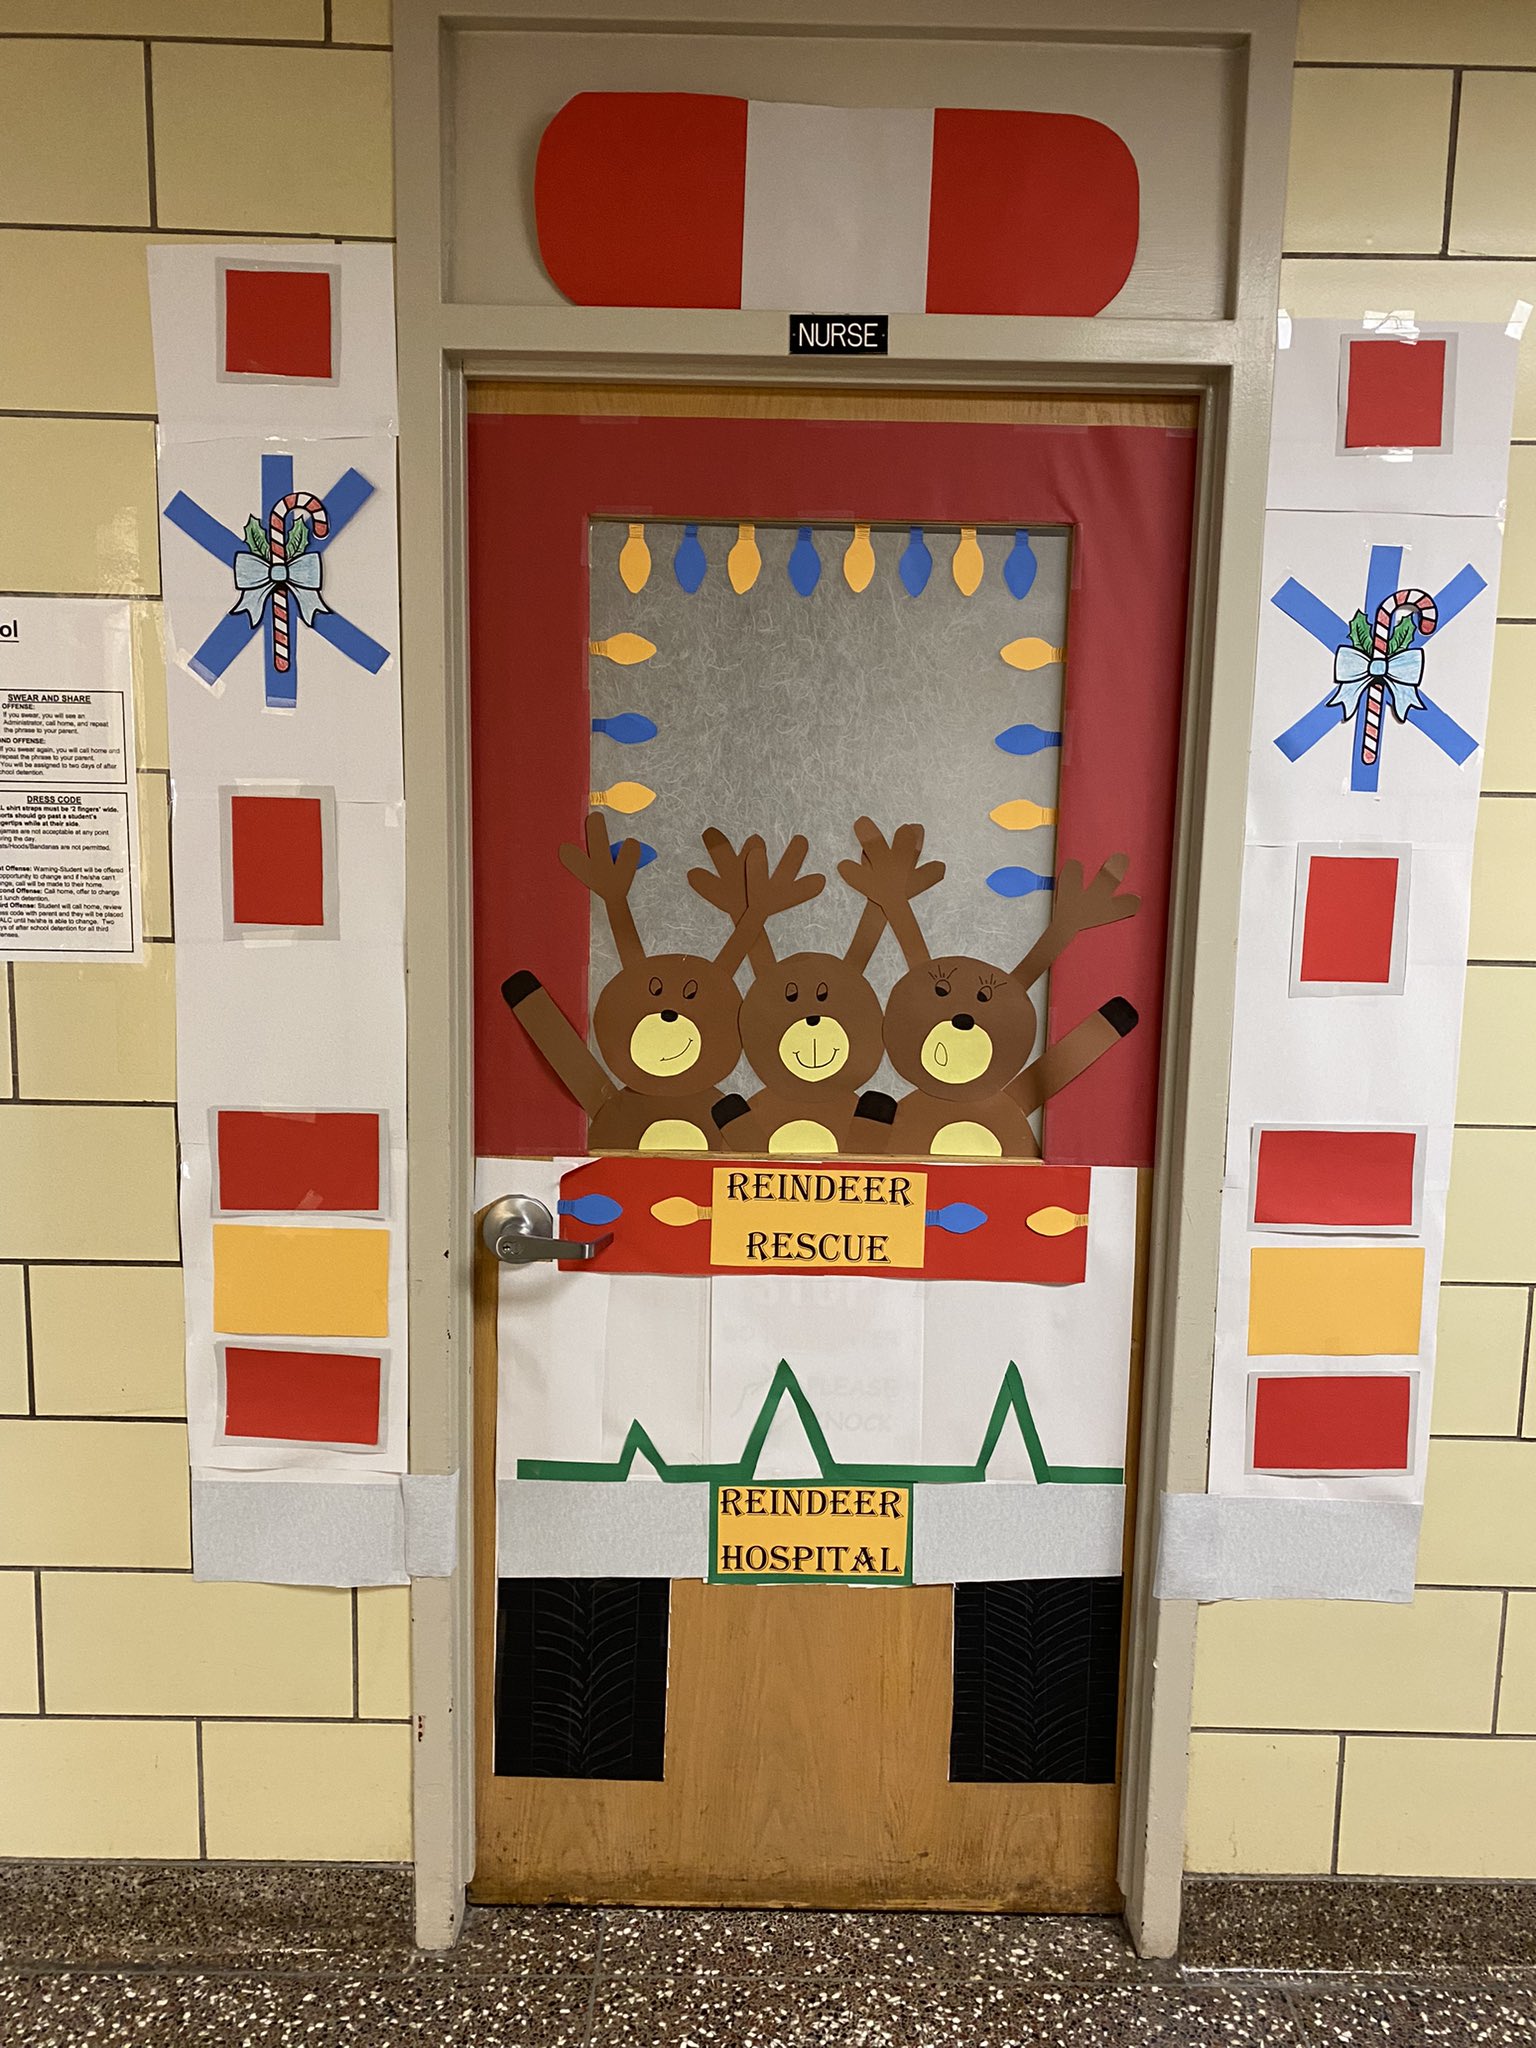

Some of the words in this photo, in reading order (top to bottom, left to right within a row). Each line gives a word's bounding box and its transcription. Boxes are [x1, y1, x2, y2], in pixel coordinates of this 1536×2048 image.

[799, 323, 878, 347] NURSE
[0, 619, 18, 637] ol
[8, 694, 39, 702] SWEAR
[42, 695, 60, 703] AND
[62, 695, 91, 703] SHARE
[27, 796, 55, 804] DRESS
[57, 796, 81, 804] CODE
[71, 911, 83, 919] they
[727, 1172, 914, 1207] REINDEER
[746, 1231, 891, 1264] RESCUE
[720, 1488, 905, 1521] REINDEER
[720, 1545, 902, 1575] HOSPITAL
